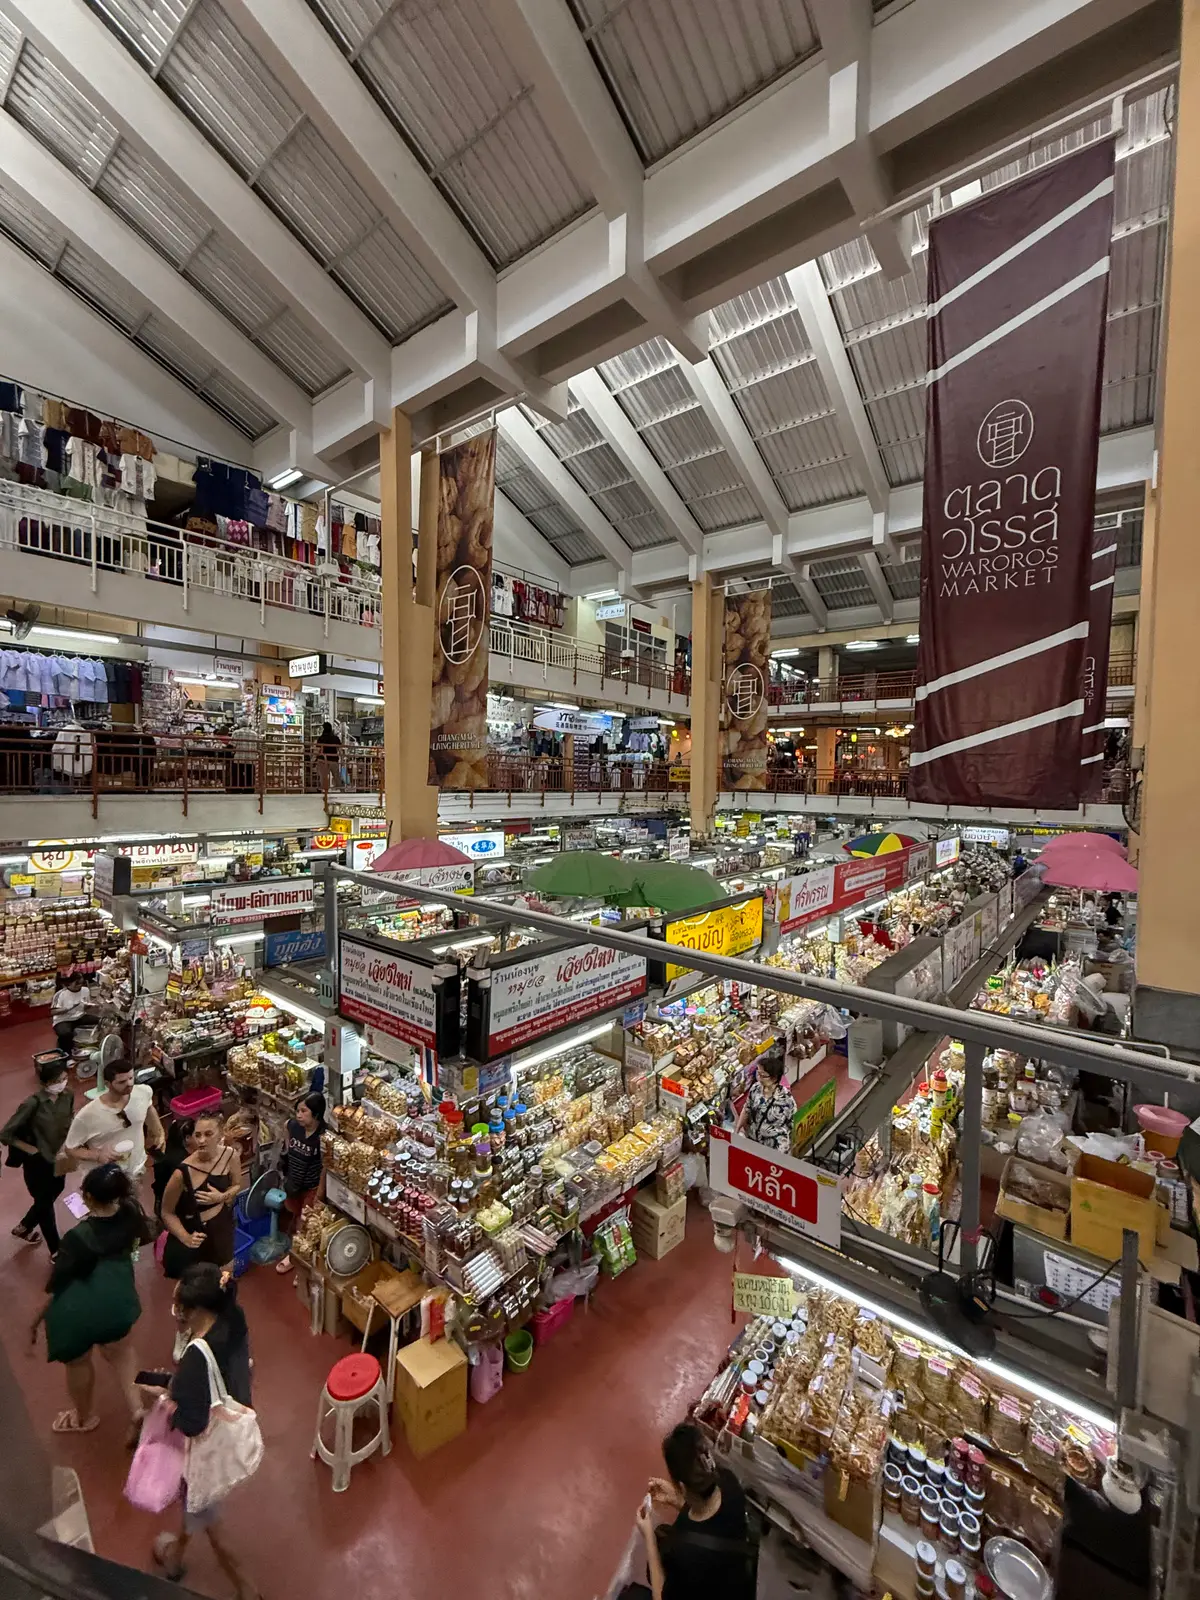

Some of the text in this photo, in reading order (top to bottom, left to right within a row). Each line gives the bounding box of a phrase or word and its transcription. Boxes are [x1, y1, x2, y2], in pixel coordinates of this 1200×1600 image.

[944, 466, 1060, 520] ตลาด
[942, 502, 1058, 559] วโรรส
[941, 546, 1058, 578] WAROROS
[940, 566, 1058, 597] MARKET
[507, 974, 545, 997] หมูยอ
[744, 1165, 797, 1208] หล้า
